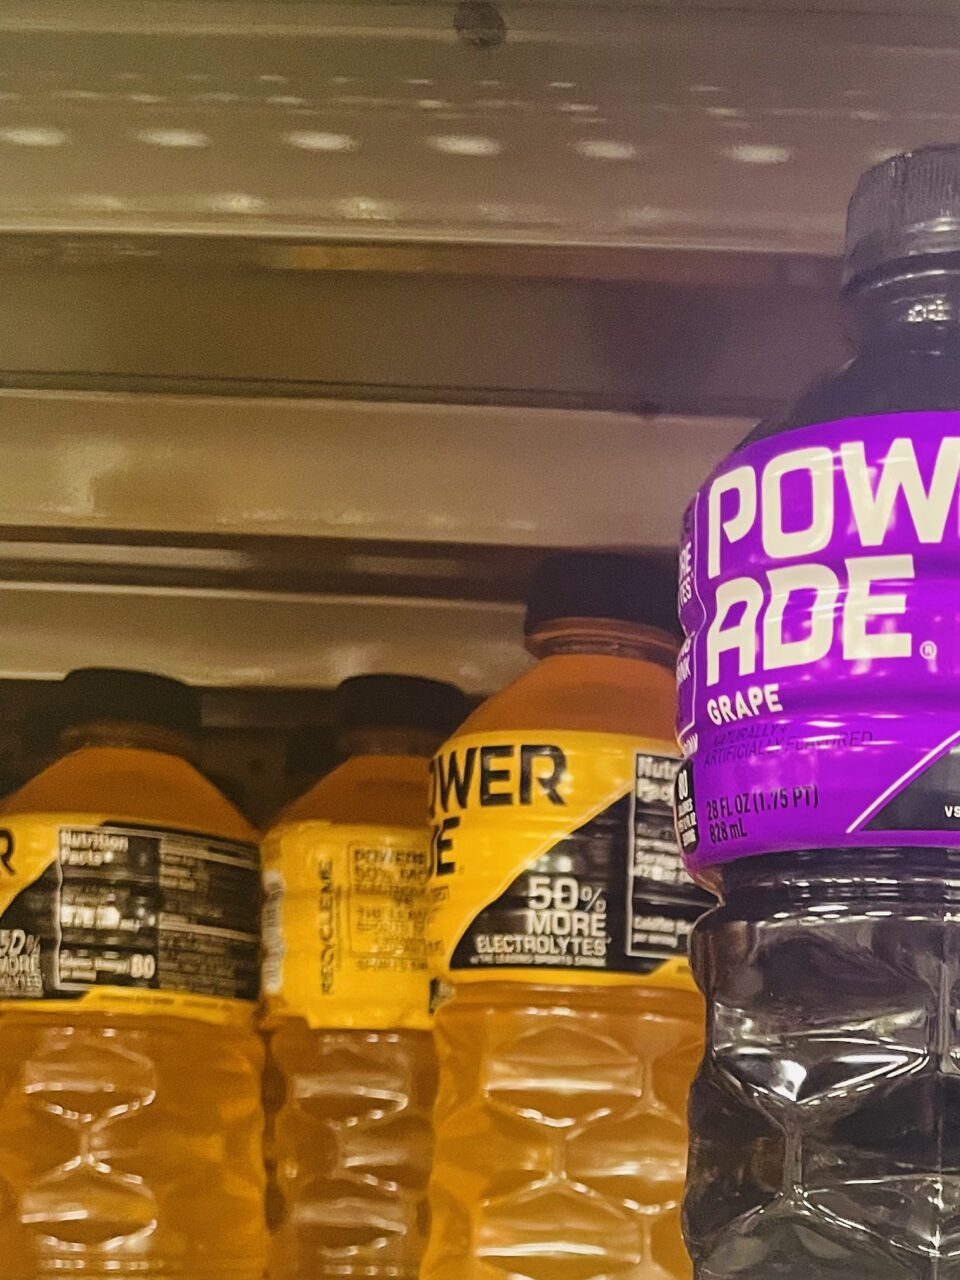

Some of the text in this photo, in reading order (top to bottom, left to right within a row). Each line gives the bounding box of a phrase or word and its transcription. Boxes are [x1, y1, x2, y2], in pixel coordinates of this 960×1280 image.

[706, 554, 915, 687] ADE
[707, 684, 783, 726] GRAPE
[704, 737, 784, 767] ARTIFICIALLY
[430, 744, 568, 816] WER
[707, 784, 819, 821] 28 FL OZ (1.75 PT)
[709, 818, 747, 844] 828 mL
[527, 875, 607, 912] 50%
[526, 910, 607, 937] MORE
